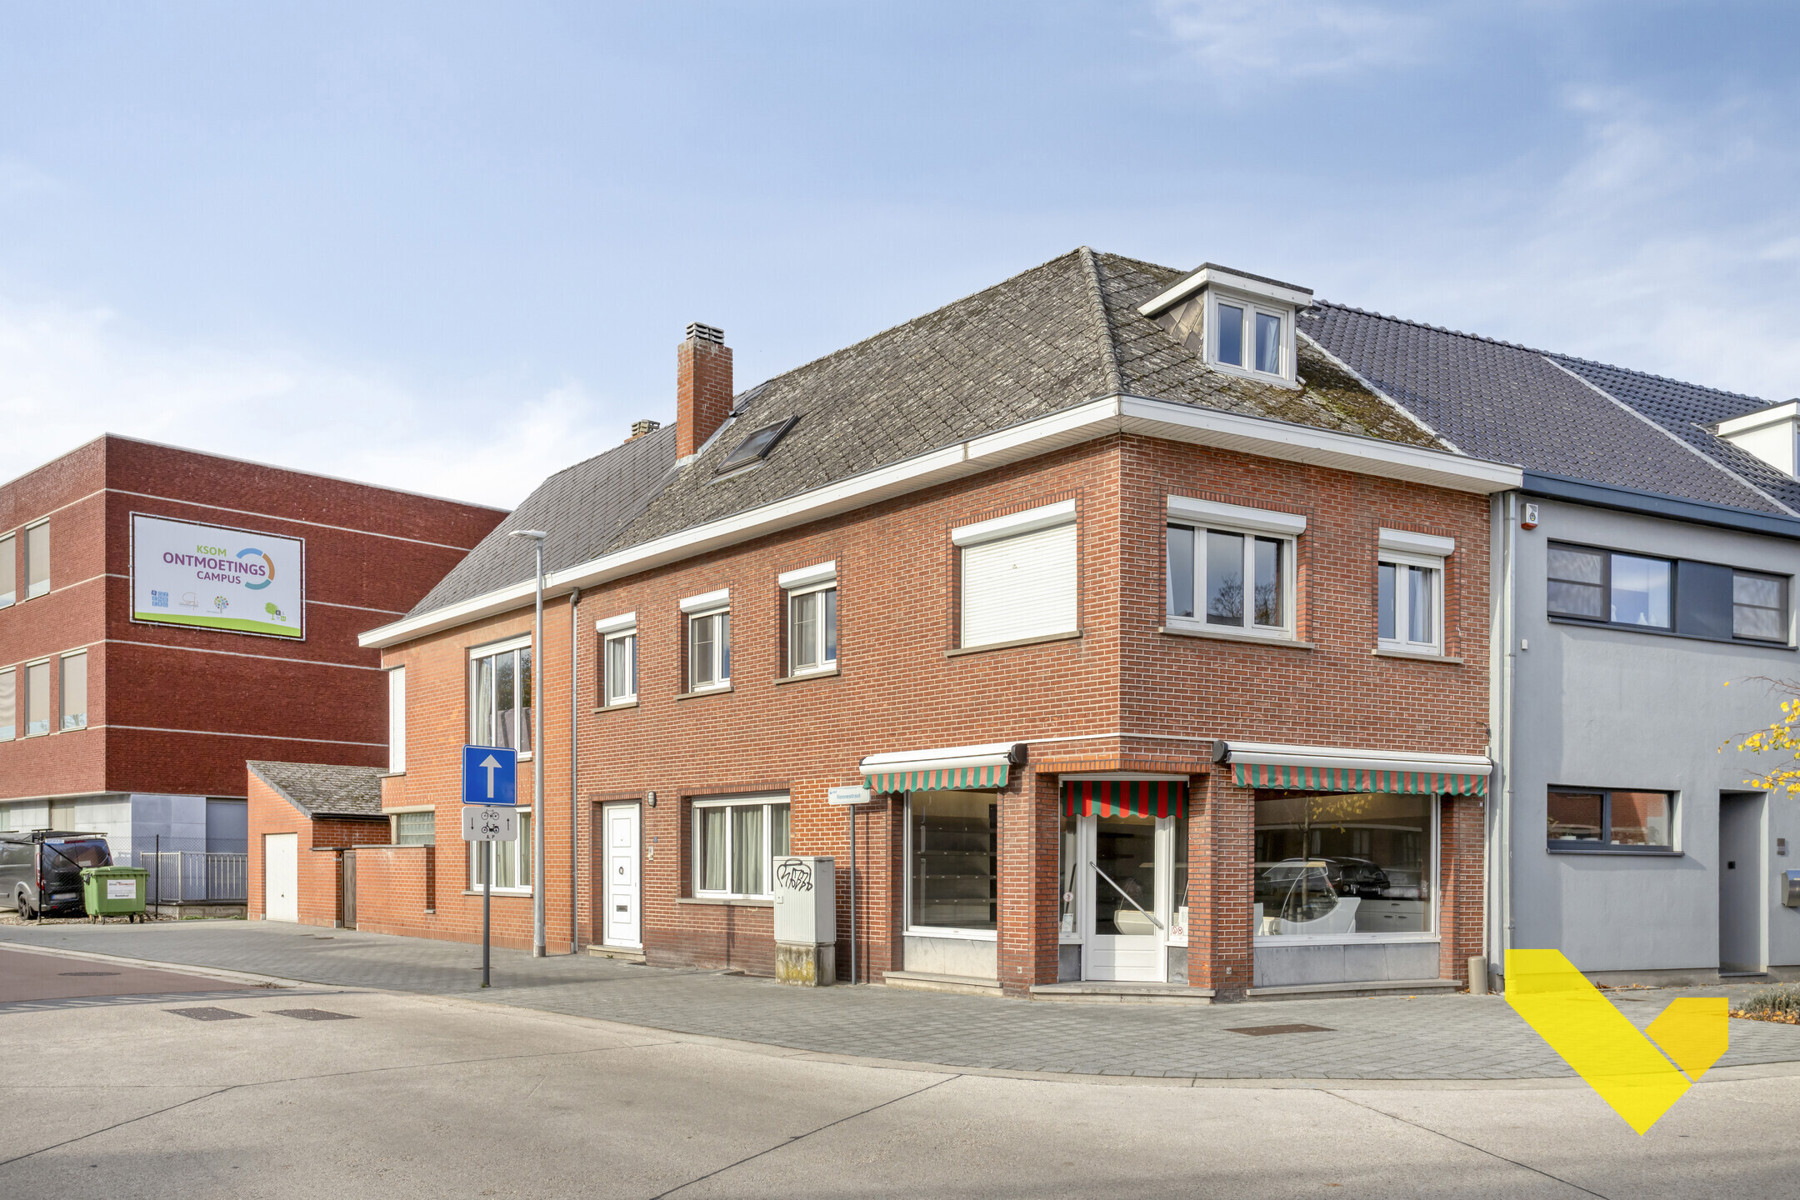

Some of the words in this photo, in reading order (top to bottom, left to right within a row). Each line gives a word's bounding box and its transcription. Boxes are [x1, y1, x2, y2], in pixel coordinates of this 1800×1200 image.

[196, 545, 227, 557] KSOM
[163, 552, 266, 577] ONTMOETINGS
[196, 571, 242, 585] CAMPUS
